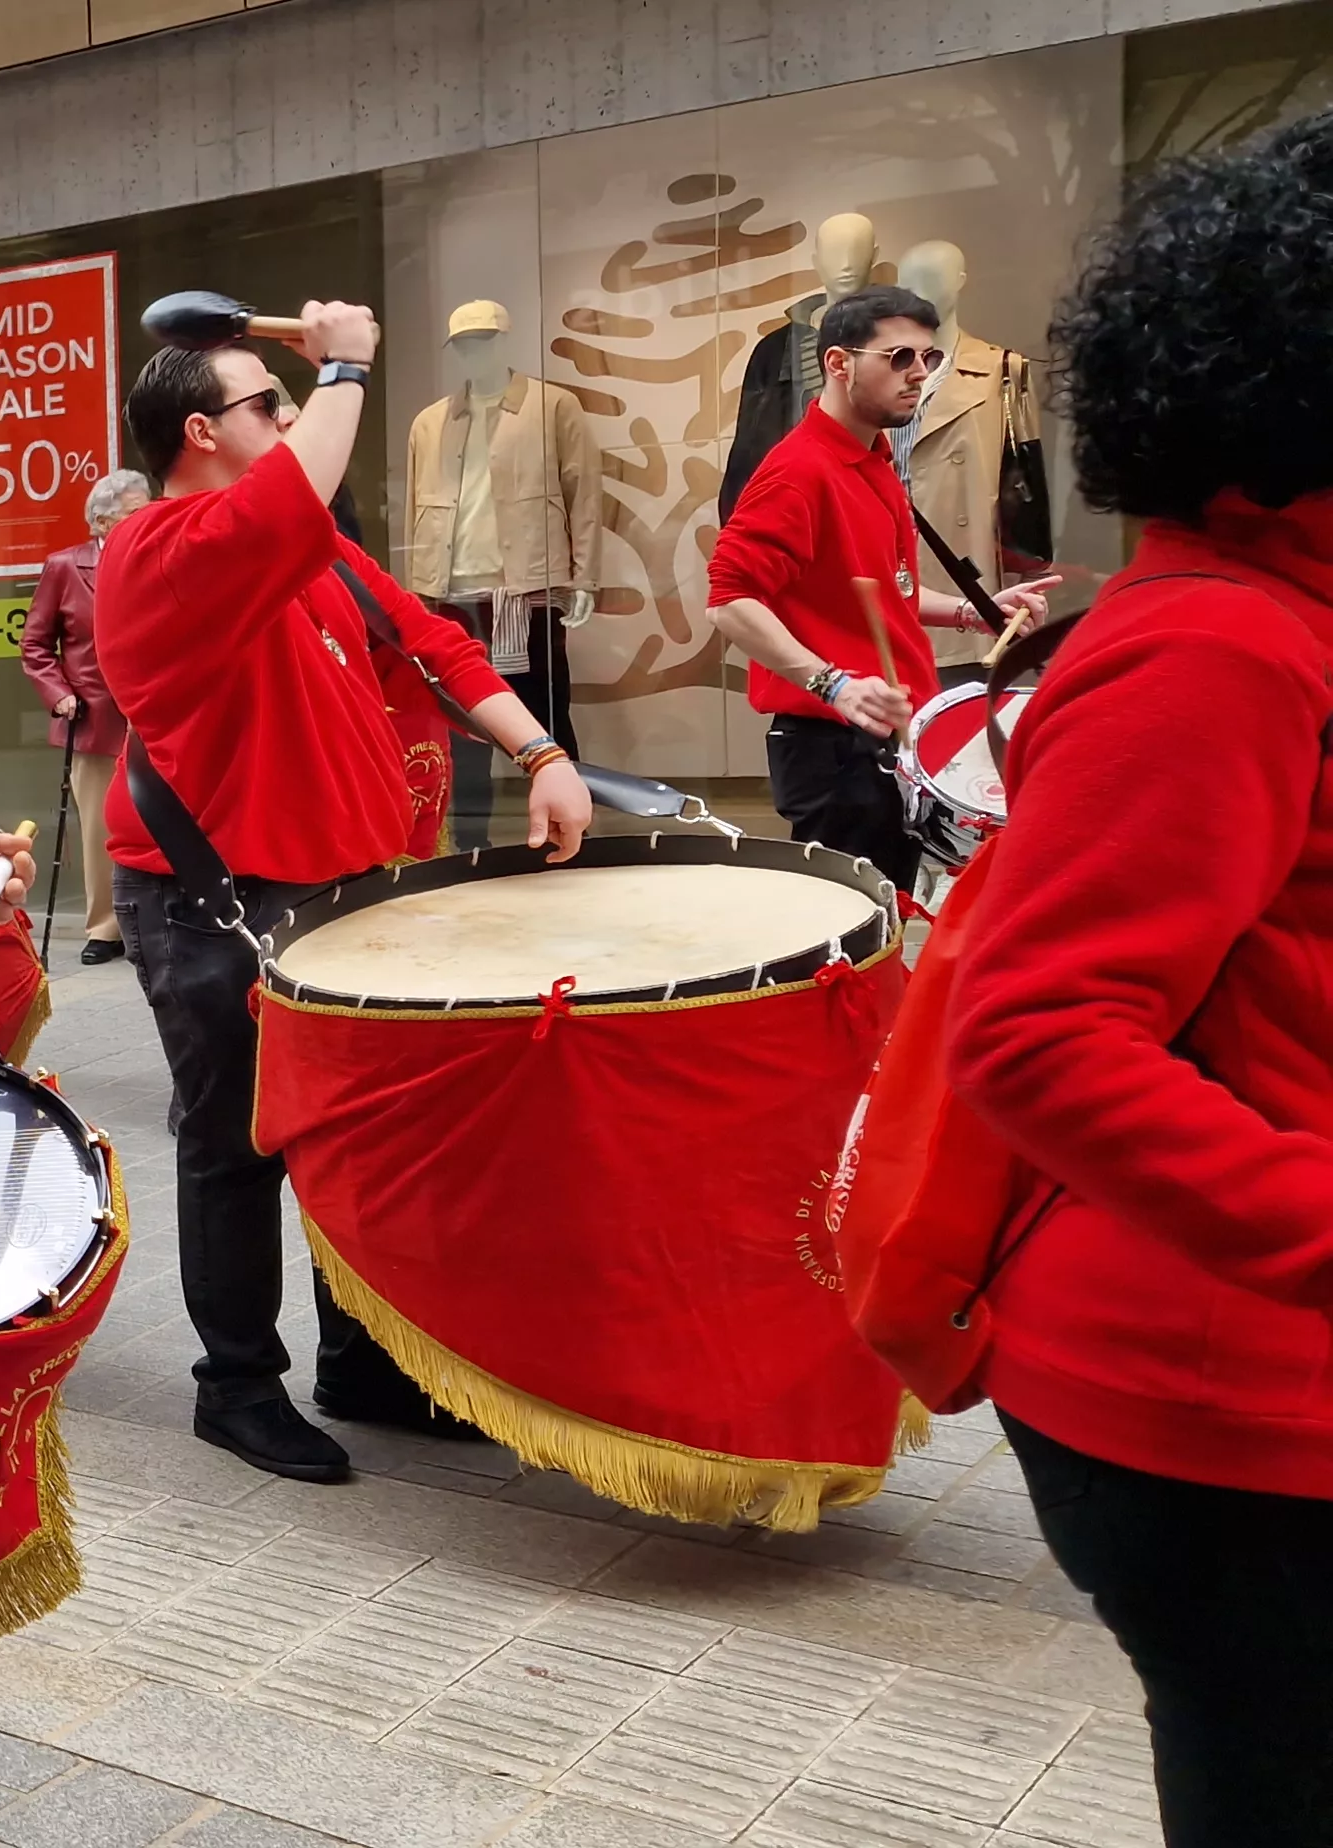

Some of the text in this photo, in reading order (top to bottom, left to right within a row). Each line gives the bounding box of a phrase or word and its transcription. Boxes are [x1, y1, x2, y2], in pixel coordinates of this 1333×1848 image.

[795, 1197, 814, 1218] DE
[811, 1169, 833, 1189] LA
[0, 1387, 26, 1417] LA
